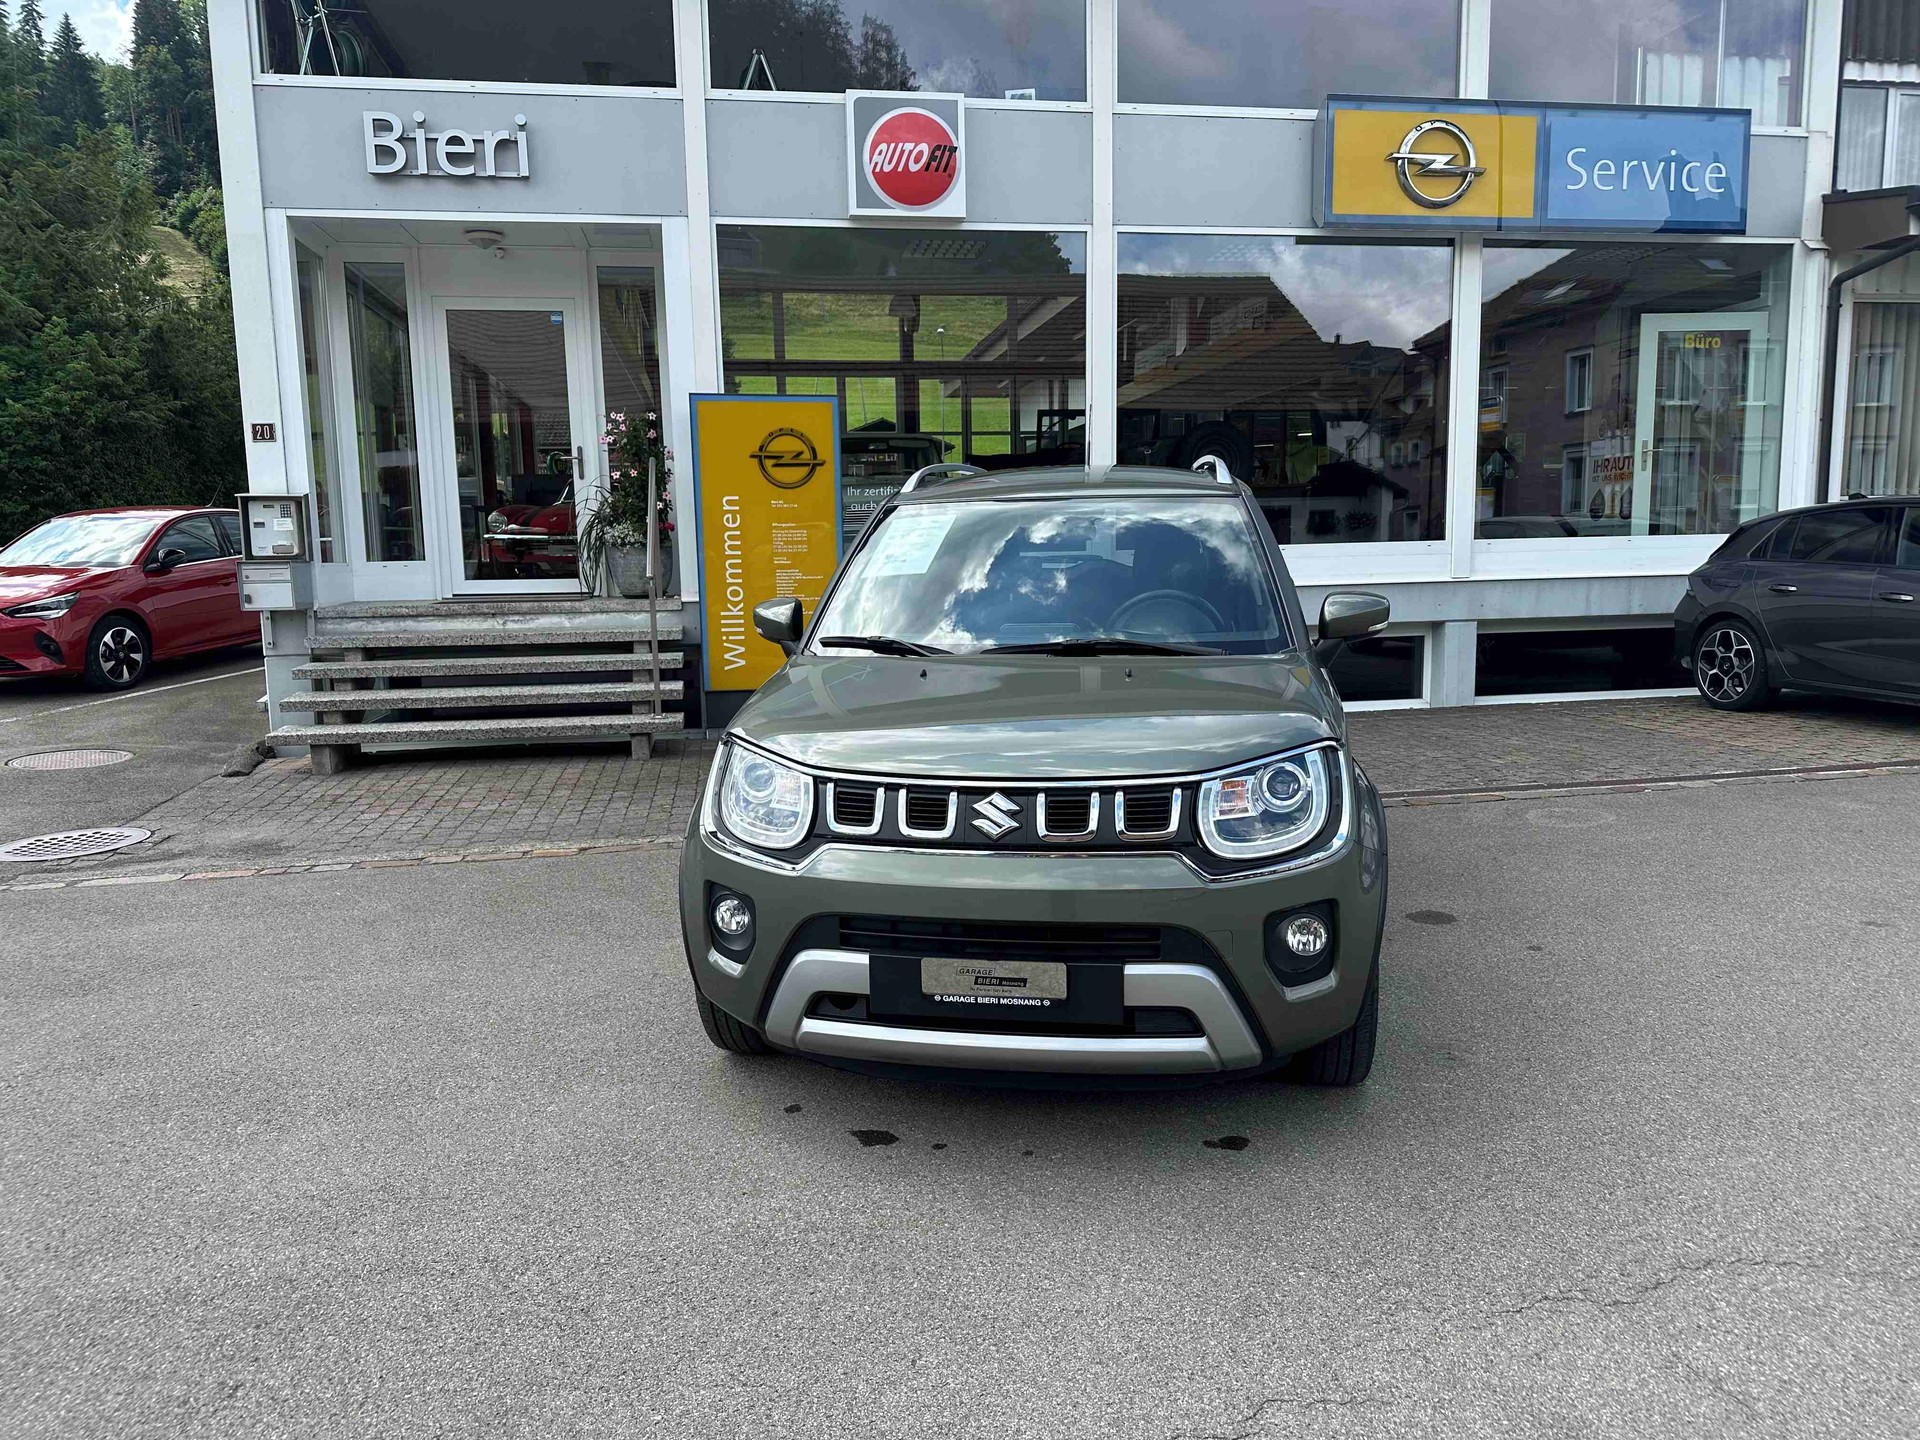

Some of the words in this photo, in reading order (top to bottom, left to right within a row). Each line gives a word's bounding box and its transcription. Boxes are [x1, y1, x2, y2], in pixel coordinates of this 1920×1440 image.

[363, 110, 529, 177] Bieri
[870, 142, 958, 173] AUTOFIT
[1566, 147, 1727, 193] Service
[1684, 334, 1721, 348] Büro
[256, 425, 270, 439] 20
[1593, 458, 1610, 473] IHR
[1610, 455, 1634, 471] AUT
[847, 486, 861, 496] Ihr
[864, 486, 901, 496] zertifi
[720, 495, 746, 671] Willkommen
[959, 967, 994, 976] GARAGE
[977, 977, 1000, 985] BIERI
[943, 995, 976, 1003] GARAGE
[1000, 998, 1041, 1006] MOSNANG
